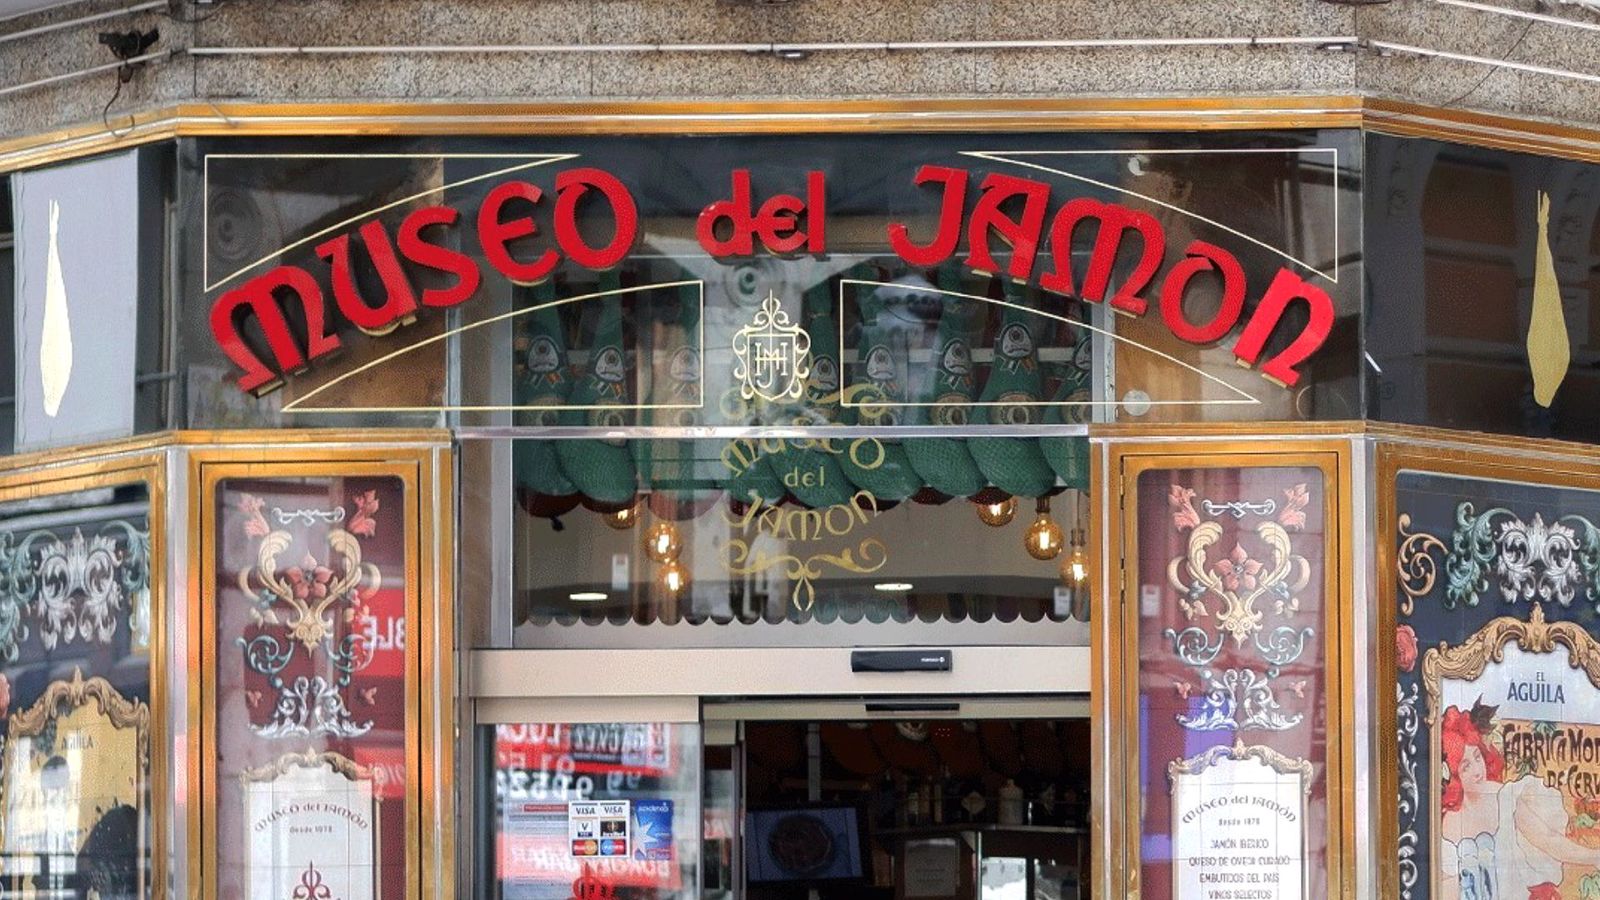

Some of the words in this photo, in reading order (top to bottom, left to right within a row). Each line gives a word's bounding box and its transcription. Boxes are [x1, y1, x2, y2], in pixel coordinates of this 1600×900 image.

[209, 167, 638, 393] MUSEO
[696, 169, 825, 256] del
[888, 165, 1336, 387] JAMON
[783, 466, 825, 488] del
[1536, 671, 1544, 681] EL
[1231, 795, 1249, 805] del
[303, 803, 320, 813] del
[575, 807, 596, 815] VISA
[604, 806, 623, 814] VISA
[1188, 857, 1216, 867] QUESO
[1218, 857, 1229, 867] DE
[1199, 873, 1244, 883] EMBUTIDOS
[1247, 873, 1260, 883] DEL
[1208, 890, 1232, 899] VINOS
[1234, 889, 1273, 899] SELECTOS
